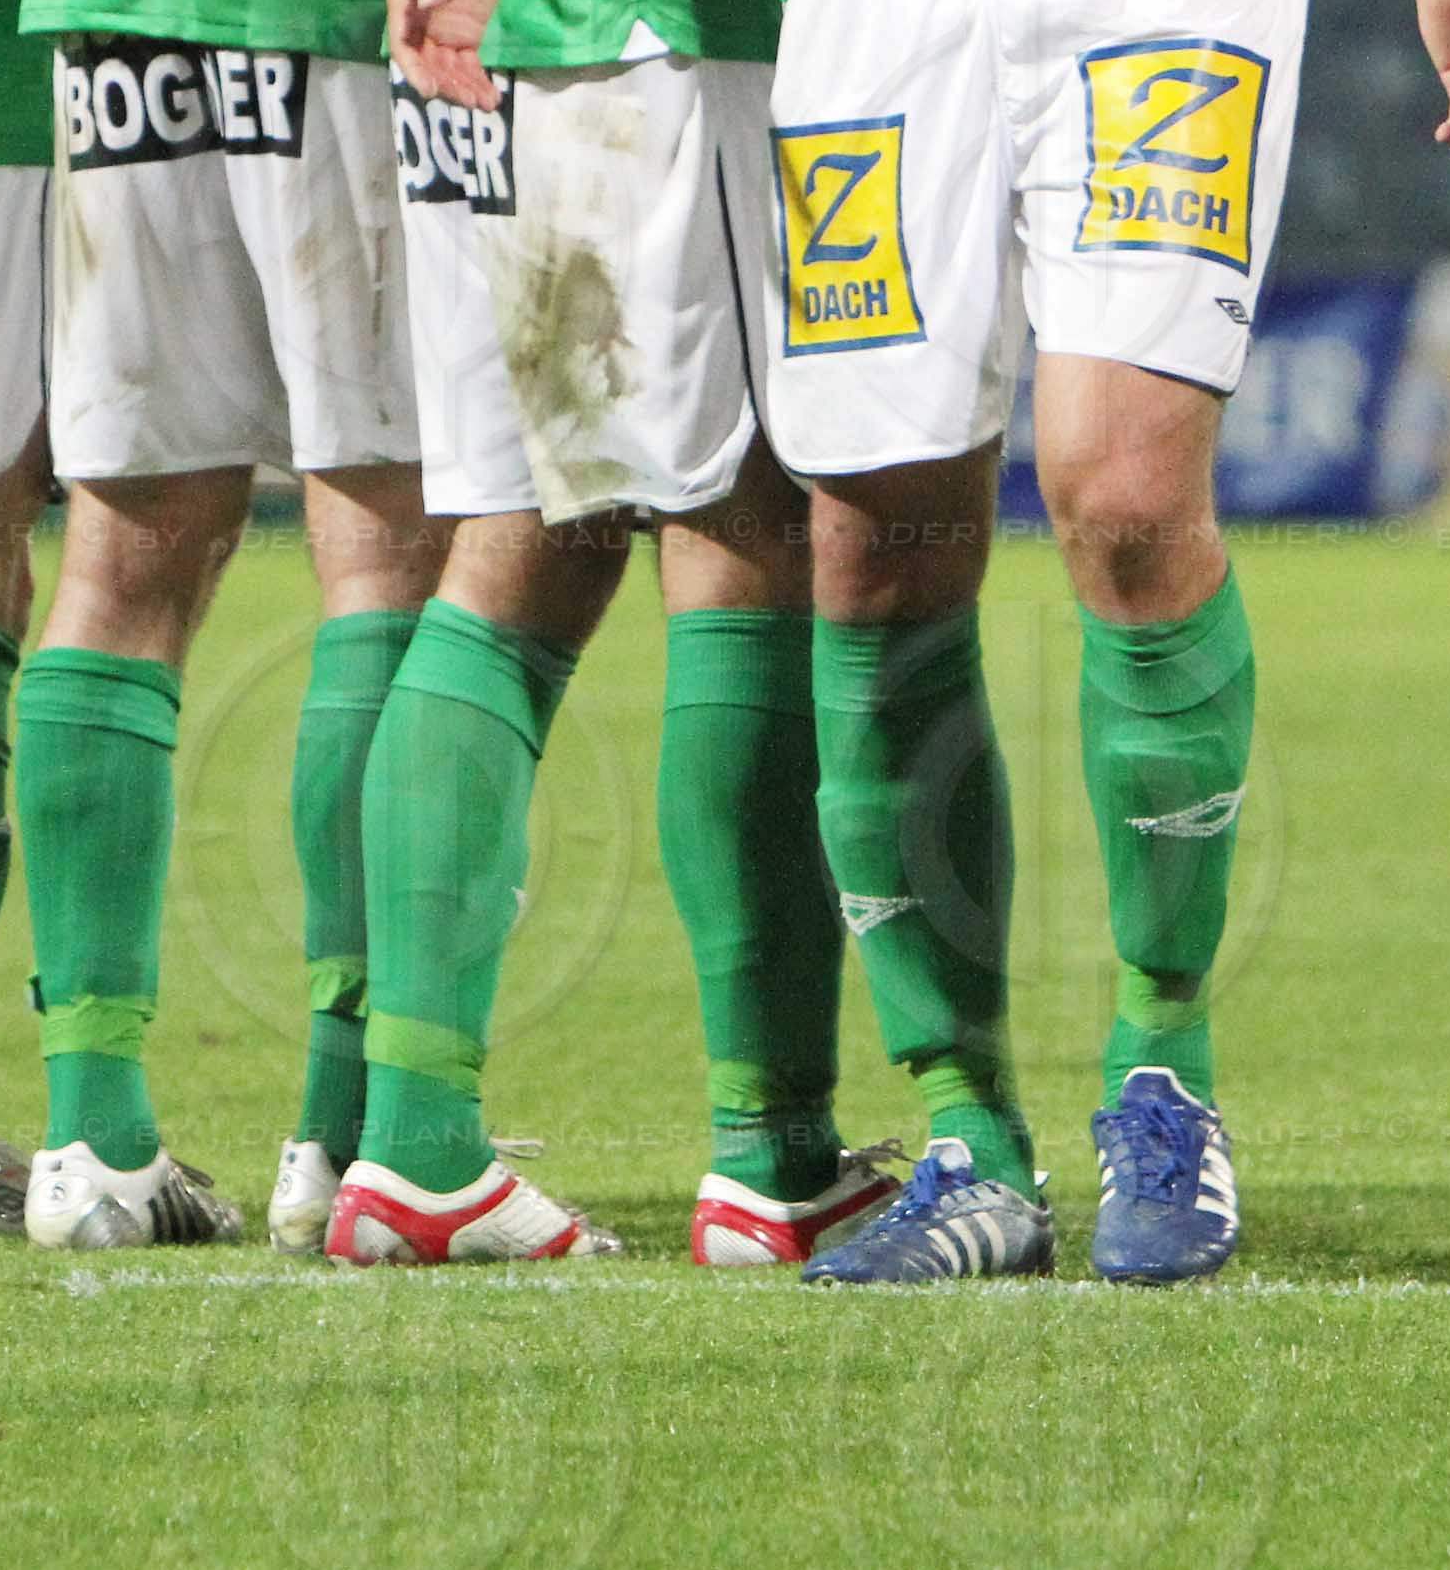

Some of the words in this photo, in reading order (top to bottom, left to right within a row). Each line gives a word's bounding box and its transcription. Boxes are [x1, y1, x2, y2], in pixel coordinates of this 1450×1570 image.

[1113, 68, 1240, 173] Z
[803, 150, 882, 266] Z
[1108, 186, 1230, 234] DACH
[804, 279, 889, 323] DACH
